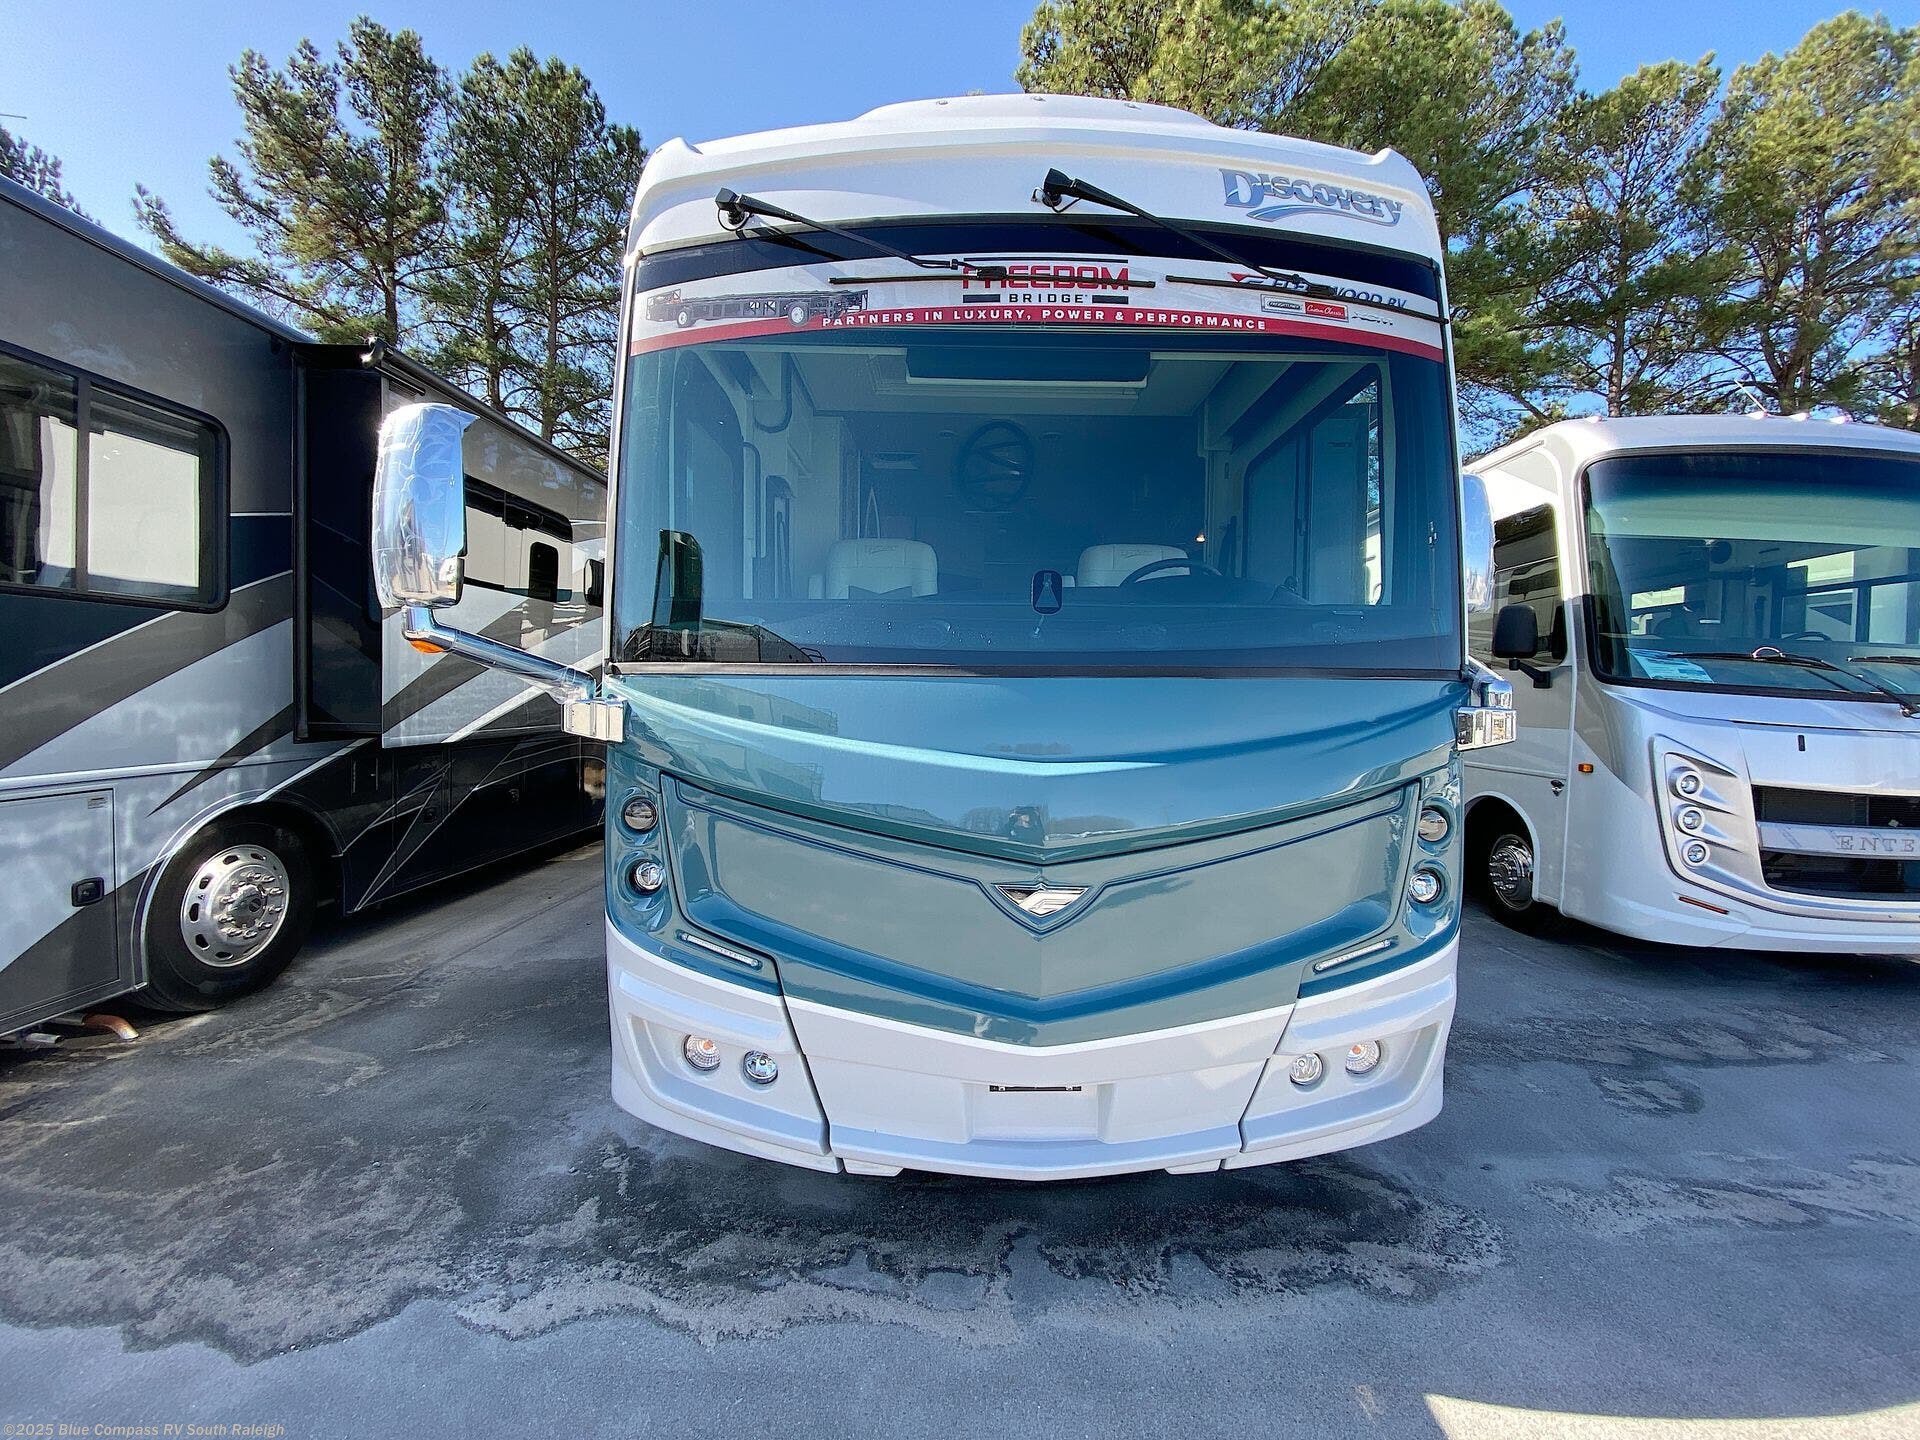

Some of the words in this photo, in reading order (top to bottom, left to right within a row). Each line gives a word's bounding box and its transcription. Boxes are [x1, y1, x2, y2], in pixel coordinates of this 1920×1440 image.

[1219, 168, 1402, 227] Discovery
[1009, 293, 1083, 303] BRIDGE
[822, 312, 914, 327] PARTNERS
[925, 311, 942, 321] IN
[954, 309, 1031, 320] LUXURY,
[1042, 309, 1105, 320] POWER
[1115, 311, 1124, 321] &
[1135, 312, 1266, 330] PERFORMANCE
